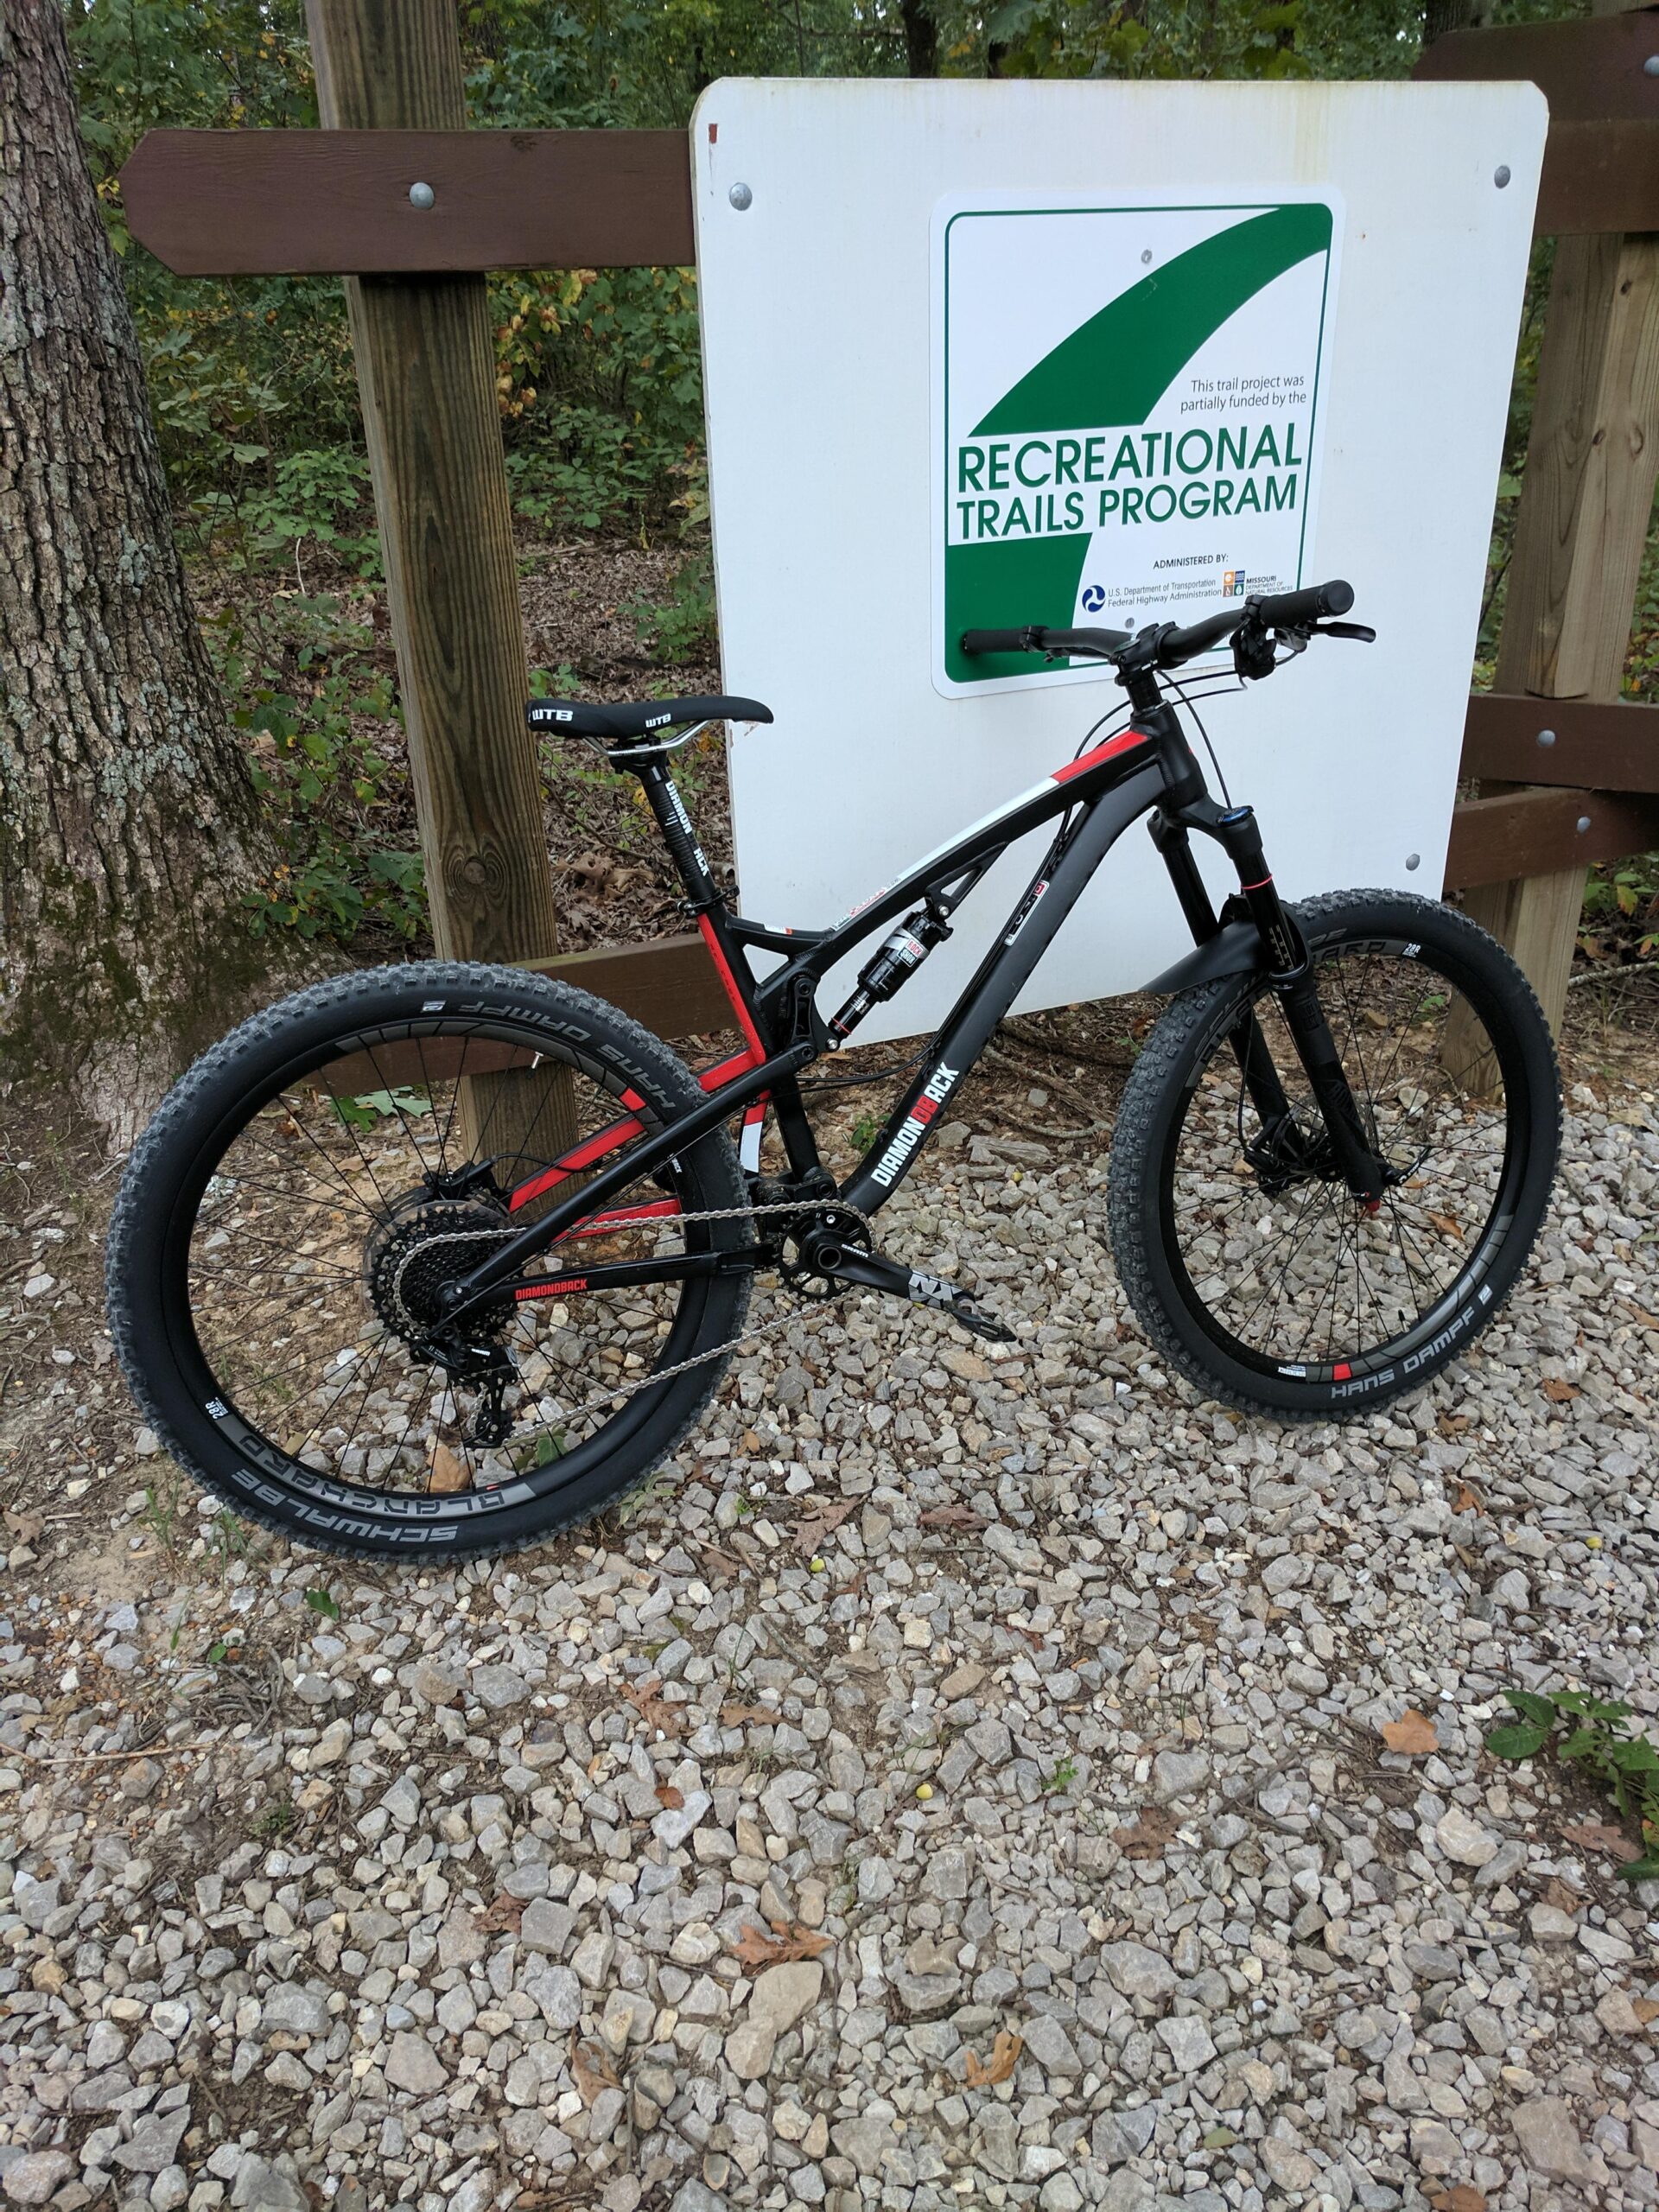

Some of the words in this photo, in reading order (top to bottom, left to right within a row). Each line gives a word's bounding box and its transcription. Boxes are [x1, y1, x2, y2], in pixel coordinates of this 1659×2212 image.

[1192, 379, 1214, 393] This
[1217, 377, 1238, 391] trail
[1241, 375, 1281, 393] project
[1283, 376, 1305, 386] was
[1180, 396, 1227, 415] partially
[1229, 392, 1269, 408] funded
[1272, 391, 1286, 408] by
[1288, 391, 1306, 404] the
[957, 423, 1302, 493] RECREATIONAL
[957, 492, 1084, 539] TRAILS
[1098, 474, 1297, 527] PROGRAM
[1153, 555, 1214, 569] ADMINISTERED
[1216, 553, 1229, 563] BY:
[1108, 588, 1122, 597] U.S.
[1124, 585, 1160, 596] Department
[1162, 582, 1170, 592] of
[1172, 578, 1216, 591] Transportation
[1245, 582, 1275, 590] DEPARTMENT
[1246, 575, 1276, 584] MISSOURI
[1108, 597, 1135, 607] Federal
[1136, 595, 1167, 605] Highway
[1169, 588, 1222, 601] Administration
[532, 709, 574, 722] WTB
[645, 713, 671, 728] WTB
[1405, 943, 1421, 954] 28R
[458, 1001, 592, 1042] DAMPF
[596, 1043, 677, 1109] HANS
[870, 1061, 960, 1188] DIAMONDBACK
[515, 1279, 588, 1300] DIAMONDBACK
[1331, 1369, 1395, 1399] HANS
[1403, 1306, 1475, 1374] DAMPF
[205, 1401, 224, 1420] 28R
[238, 1434, 505, 1515] BLANCHARD
[231, 1468, 459, 1542] SCHWALBE
